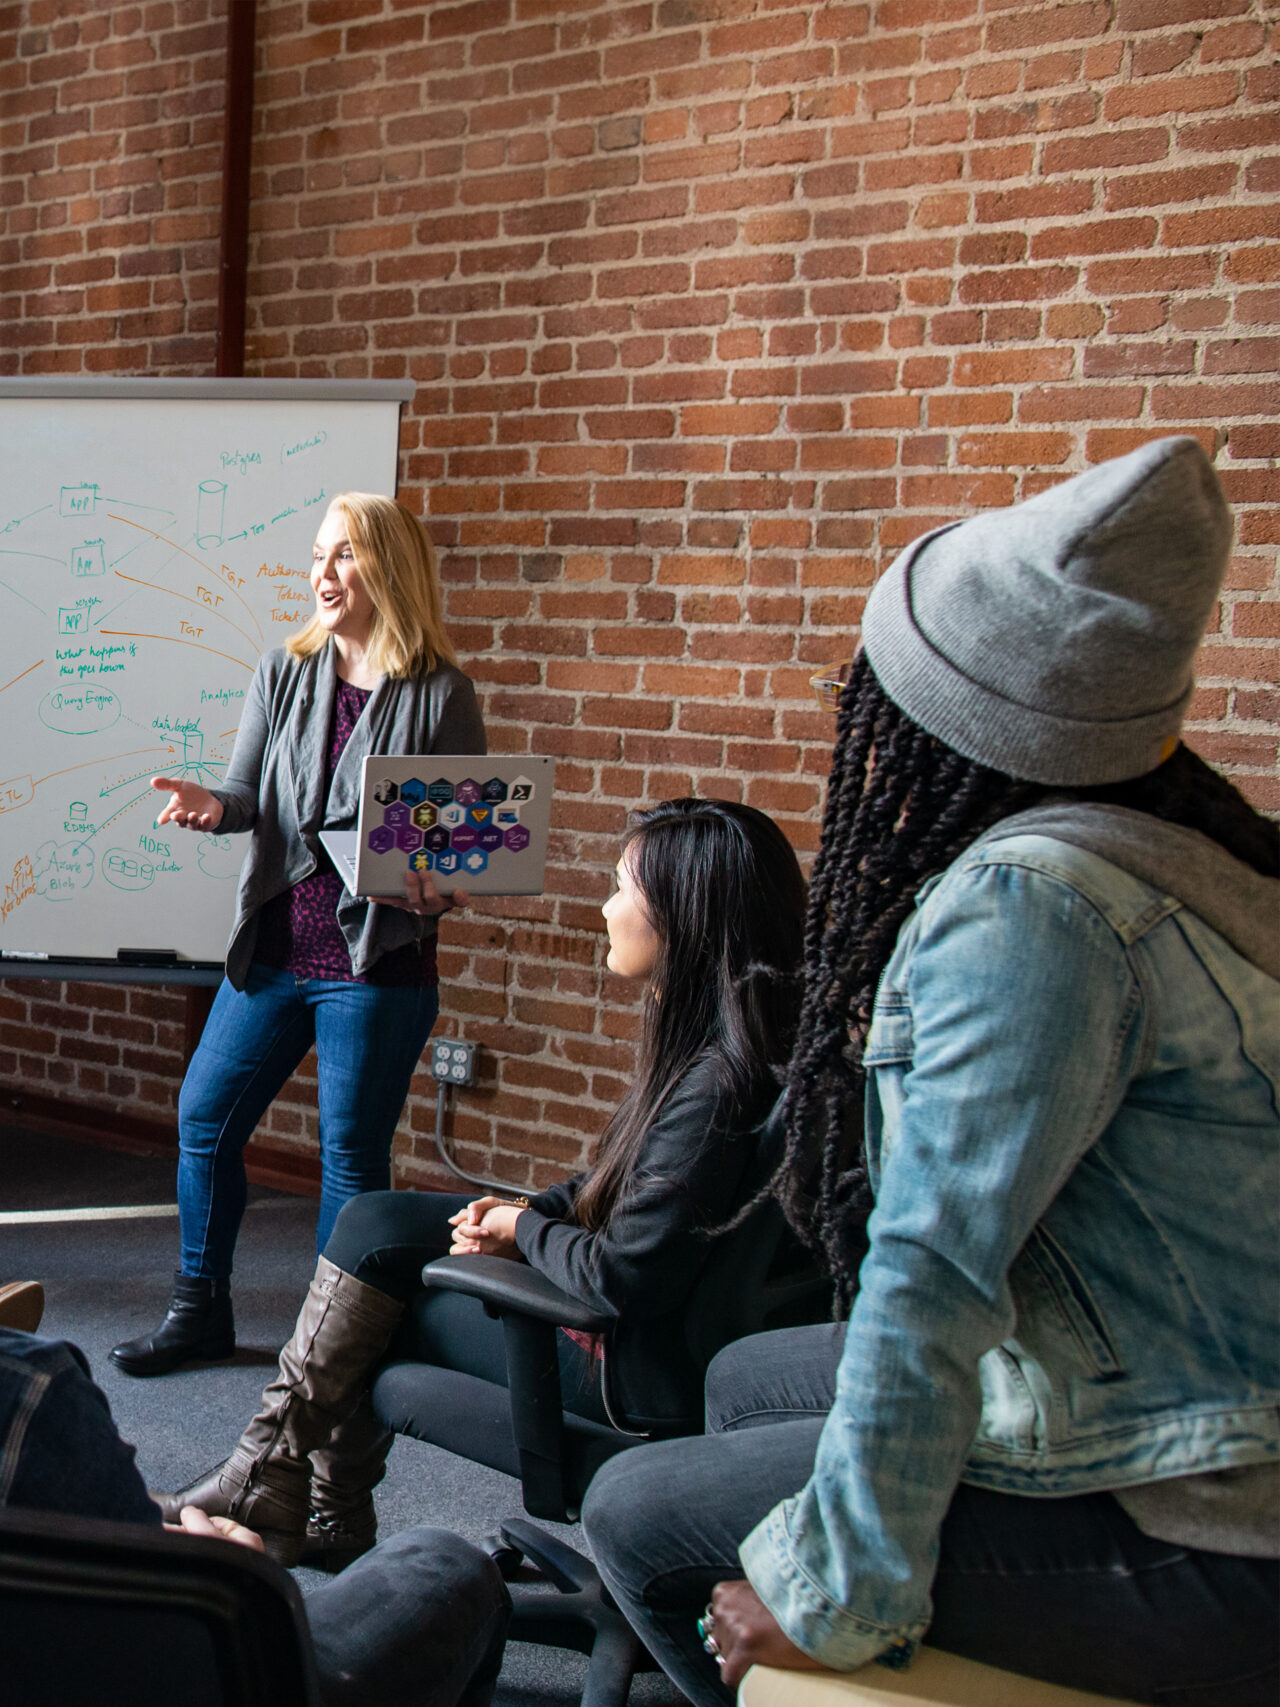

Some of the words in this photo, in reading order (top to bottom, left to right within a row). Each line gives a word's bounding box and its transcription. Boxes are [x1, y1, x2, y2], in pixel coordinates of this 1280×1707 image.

[220, 449, 262, 476] Postgres
[179, 620, 205, 639] TGT
[138, 833, 172, 857] HDFS
[50, 876, 75, 890] Blob
